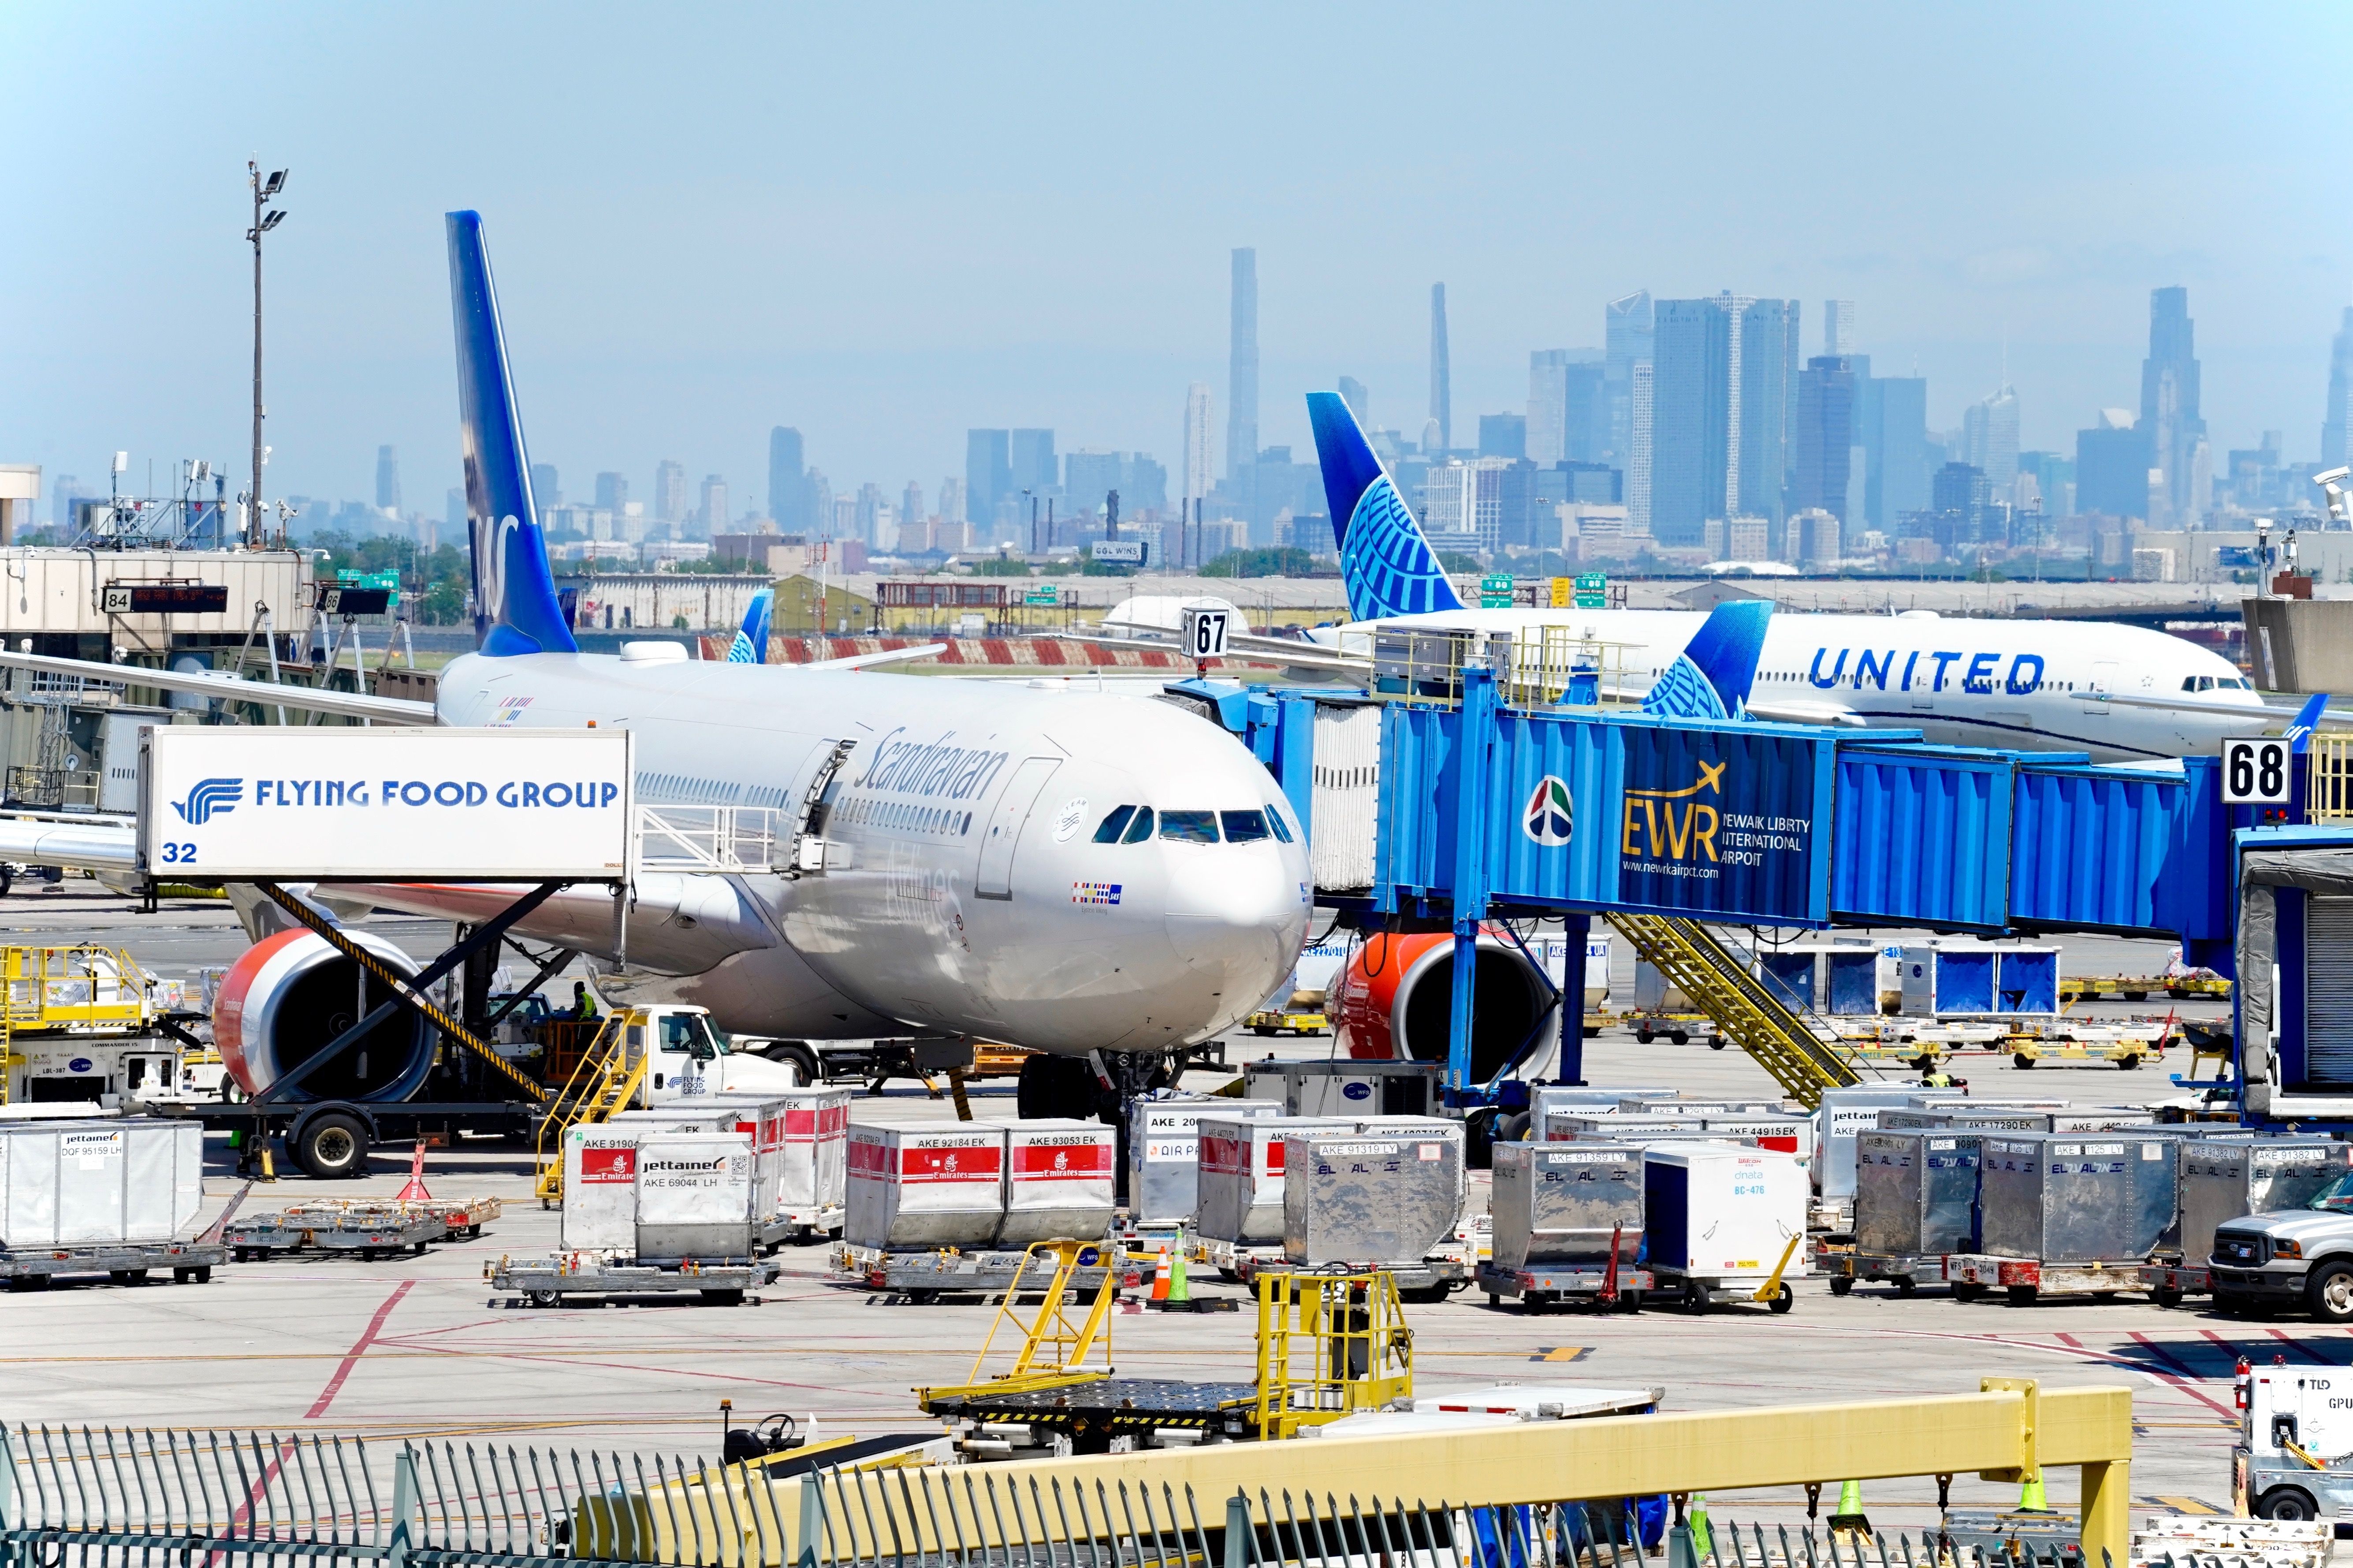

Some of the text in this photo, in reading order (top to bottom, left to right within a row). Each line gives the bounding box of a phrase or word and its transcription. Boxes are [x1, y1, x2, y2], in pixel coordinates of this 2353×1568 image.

[474, 515, 519, 617] SAS
[109, 594, 127, 607] 84
[327, 595, 338, 608] 86
[1183, 613, 1192, 653] 67
[1197, 615, 1226, 654] 67
[1811, 648, 2044, 695] UNITED
[854, 727, 1009, 801] Scandinavian
[2230, 744, 2283, 797] 68
[257, 780, 618, 808] FLYING FOOD GROUP
[1623, 798, 1719, 862] EWR
[1768, 817, 1810, 833] LIBERTY
[162, 842, 197, 863] 32
[1096, 907, 1108, 915] Viking
[1594, 945, 1605, 956] UA
[1151, 1118, 1175, 1126] AKE
[1887, 1117, 1922, 1127] AKE 17290 EK
[1208, 1128, 1217, 1136] AKE
[66, 1132, 118, 1144] jettainer
[855, 1133, 864, 1142] AKE
[875, 1136, 881, 1145] EK
[918, 1139, 939, 1148] AKE
[942, 1139, 969, 1147] 92184
[585, 1140, 606, 1148] AKE
[1322, 1144, 1396, 1155] AKE 91319 LY
[1897, 1140, 1906, 1149] LY
[1932, 1141, 1949, 1149] AKE
[1992, 1142, 2003, 1151] AKE
[2025, 1145, 2033, 1154] LY
[2057, 1144, 2122, 1154] AKE 91125 LY
[62, 1148, 80, 1156] DQF
[82, 1147, 108, 1156] 95159
[1162, 1145, 1182, 1156] AIR
[2192, 1147, 2239, 1159] AKE 91382 LY
[2258, 1150, 2324, 1160] AKE 91382 LY
[1550, 1152, 1624, 1163] AKE 91359 LY
[1863, 1154, 1891, 1165] EL AL
[642, 1156, 726, 1173] jettainer
[1318, 1164, 1369, 1174] EL AL
[1988, 1160, 2016, 1171] EL AL
[933, 1171, 968, 1180] Emirates
[1044, 1169, 1078, 1178] Emirates
[1546, 1171, 1596, 1181] EL AL
[2188, 1165, 2219, 1176] EL AL
[2256, 1169, 2300, 1178] EL AL
[644, 1178, 717, 1187] AKE 69044 LH
[1735, 1185, 1765, 1195] BC-476
[1950, 1261, 1994, 1274] WFS 3049
[2309, 1379, 2331, 1390] TLD
